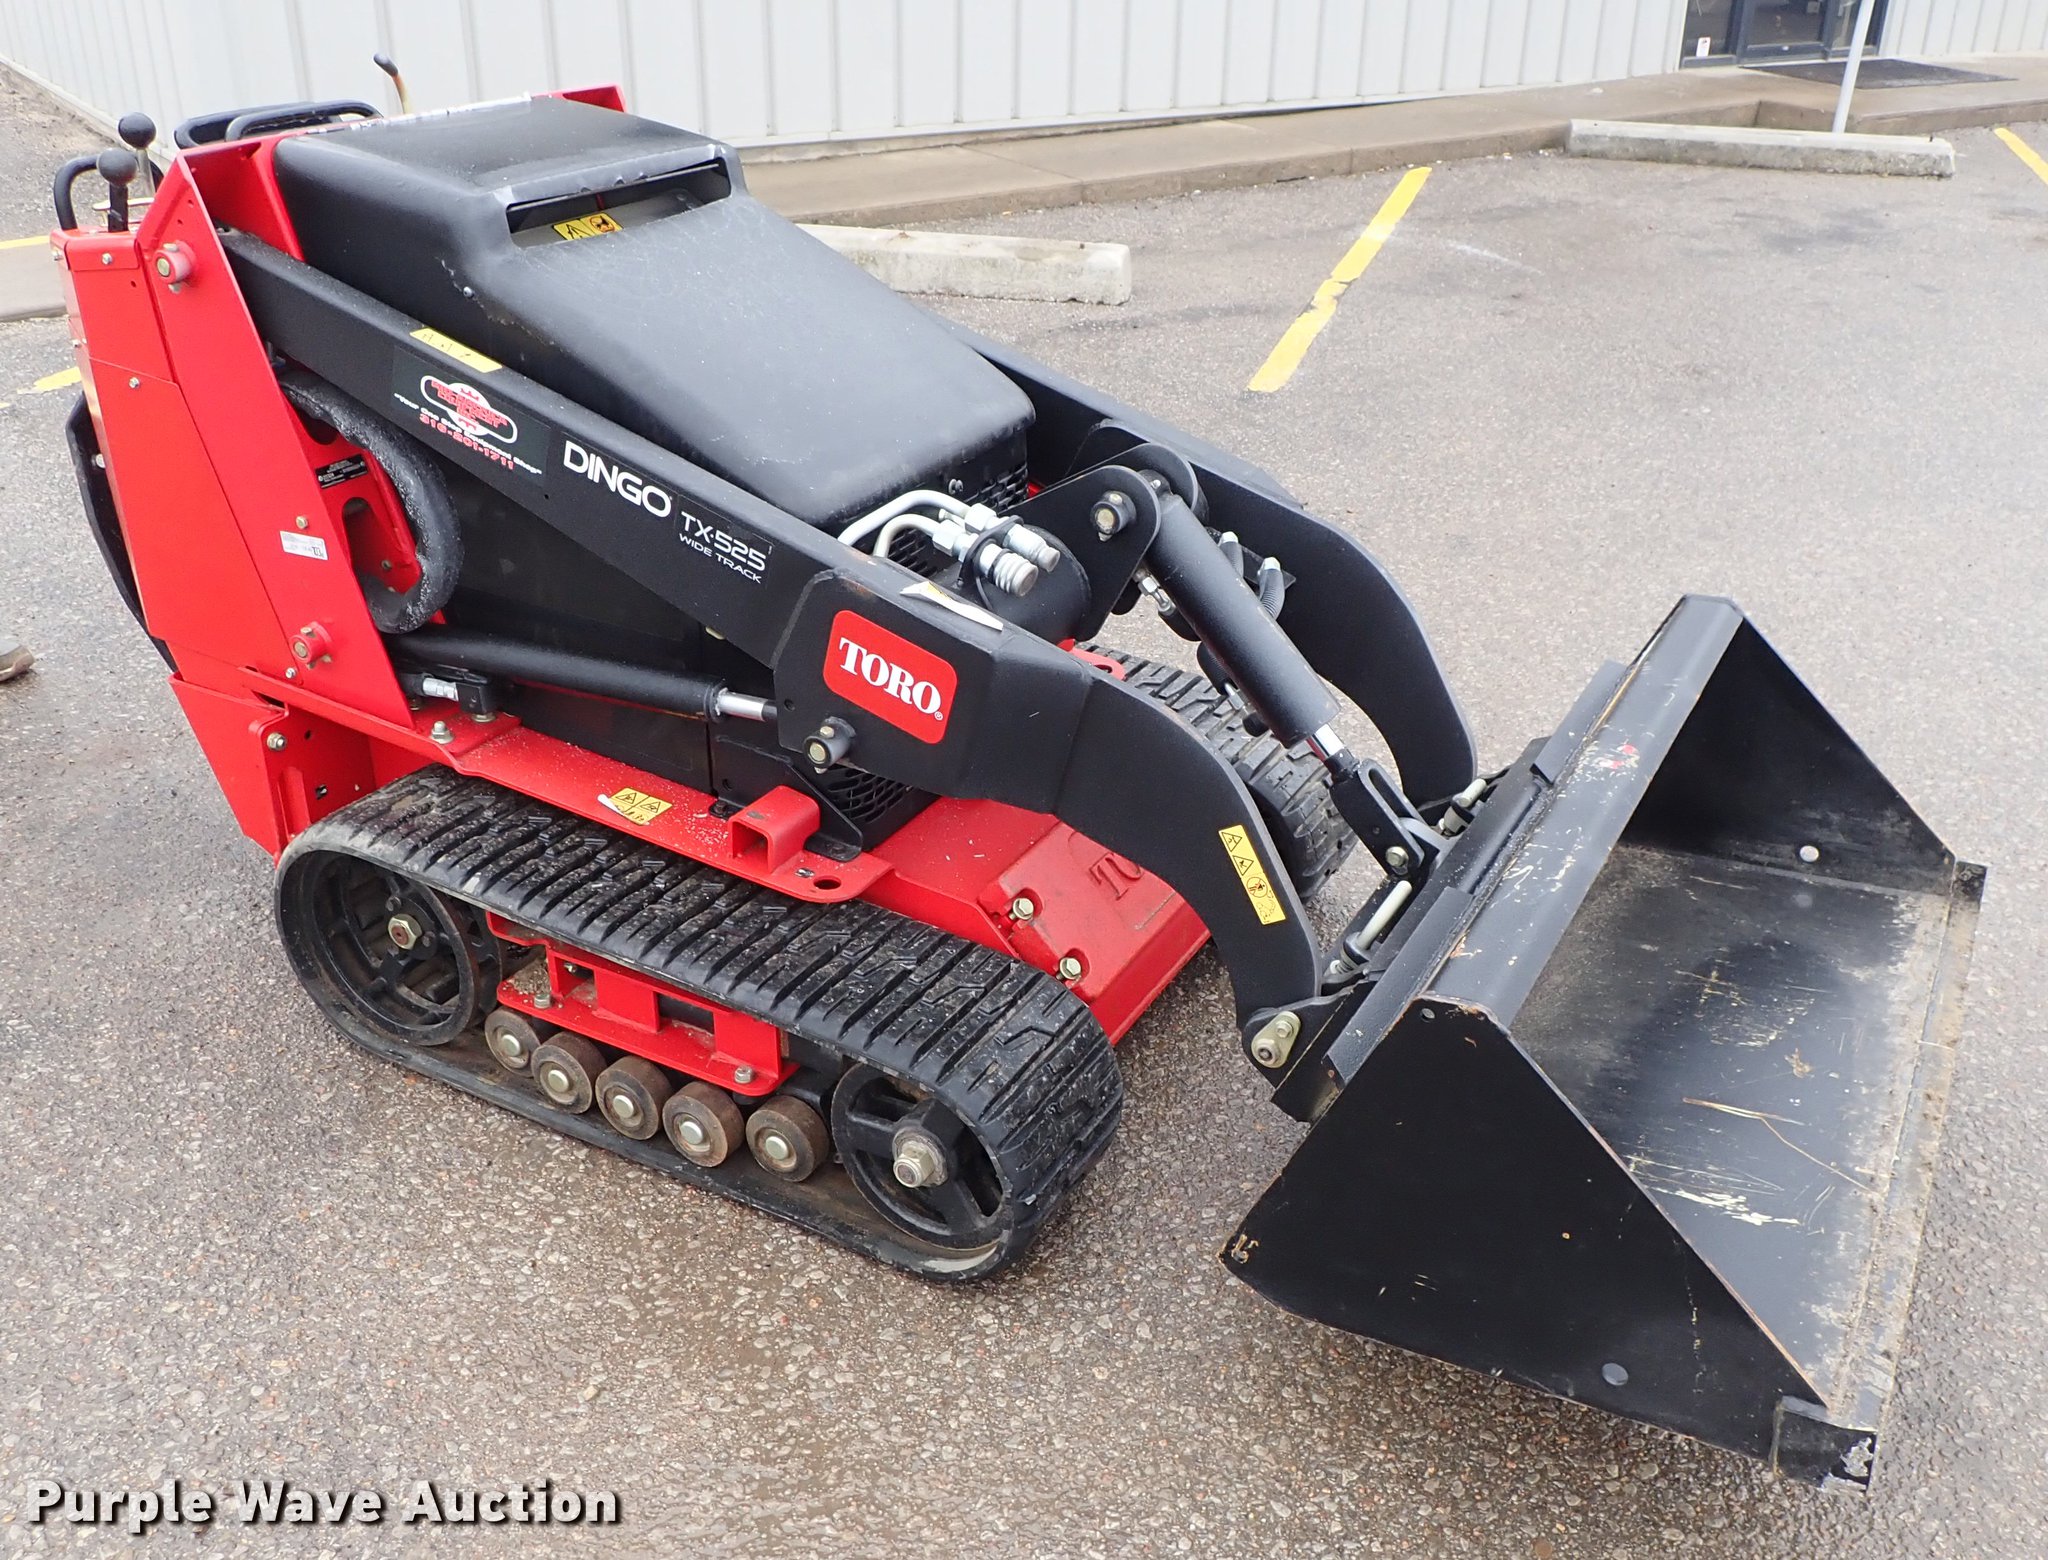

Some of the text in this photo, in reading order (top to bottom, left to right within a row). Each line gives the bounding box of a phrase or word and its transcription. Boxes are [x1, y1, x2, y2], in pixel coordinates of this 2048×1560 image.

[563, 440, 673, 518] DINGO
[679, 532, 762, 584] WIDE TRACK
